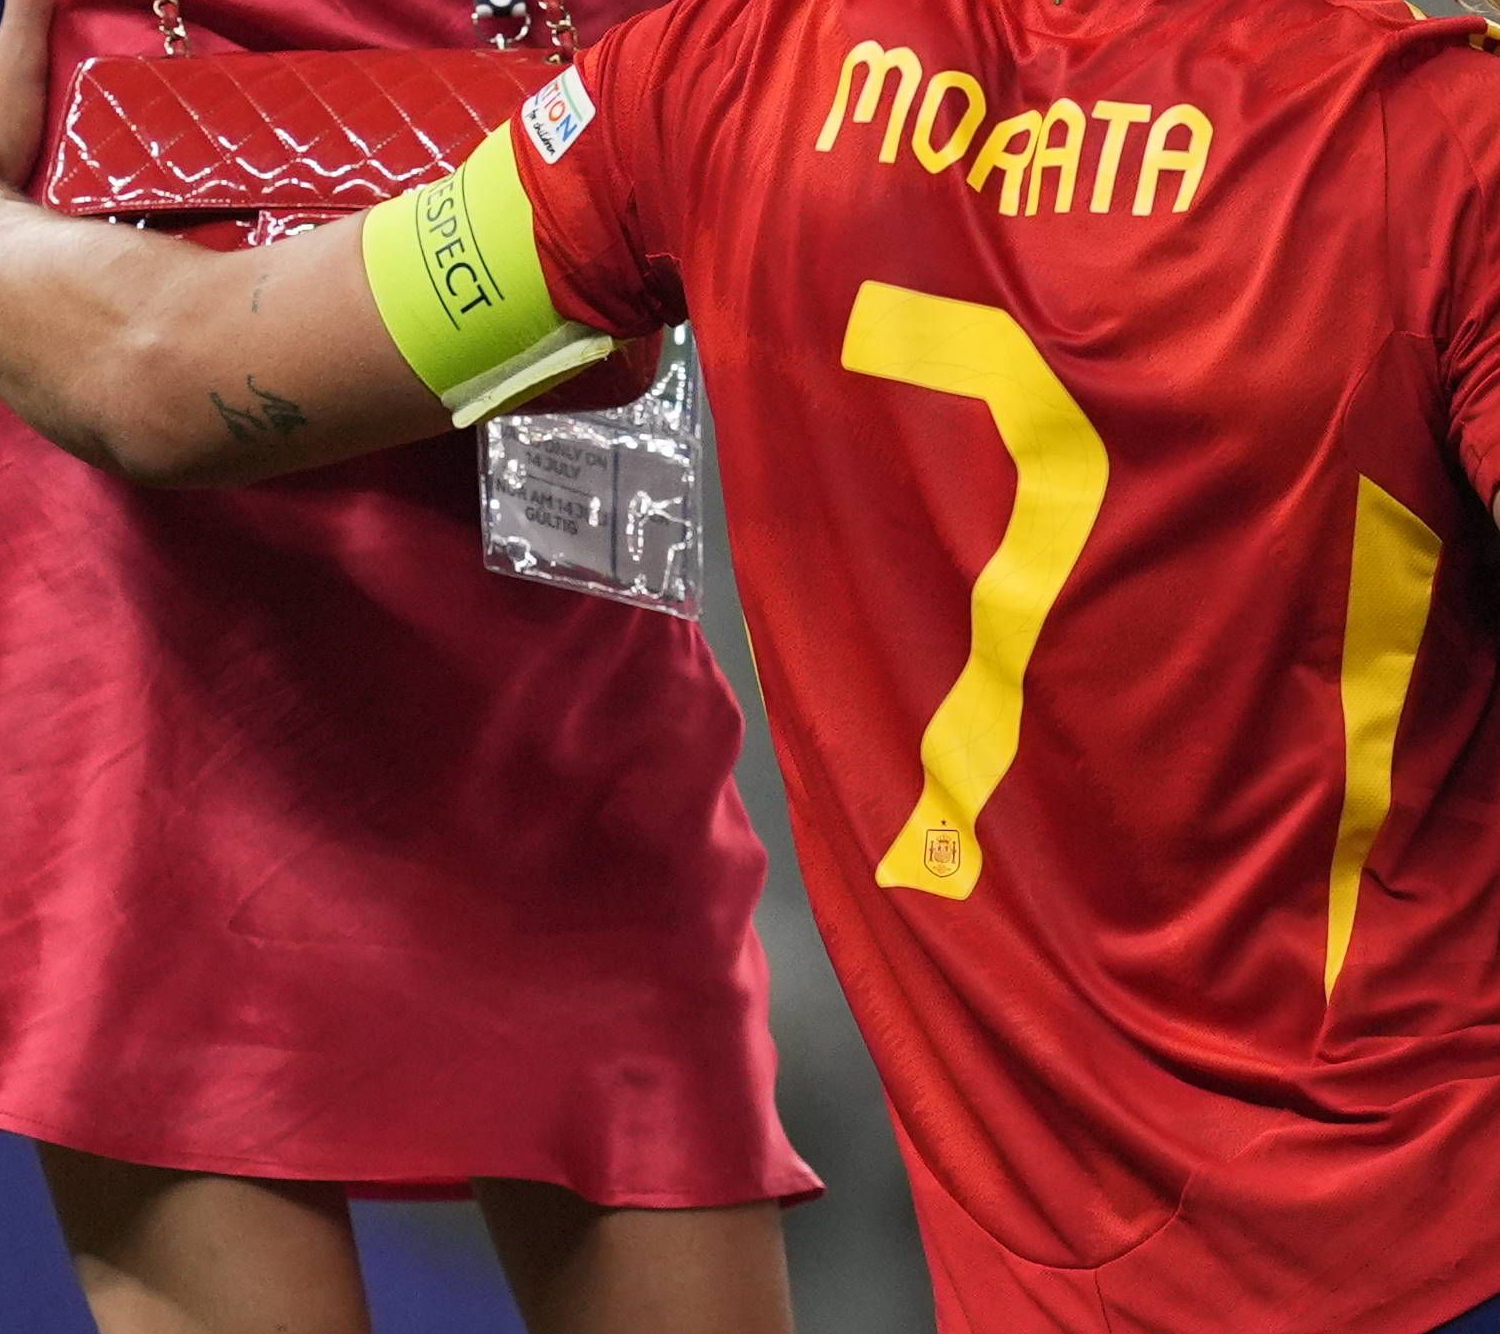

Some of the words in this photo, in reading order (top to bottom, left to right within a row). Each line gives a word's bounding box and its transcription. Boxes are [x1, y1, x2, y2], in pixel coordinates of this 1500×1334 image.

[815, 39, 1213, 216] MORATA
[425, 173, 492, 315] ESPECT
[841, 279, 1110, 900] 7
